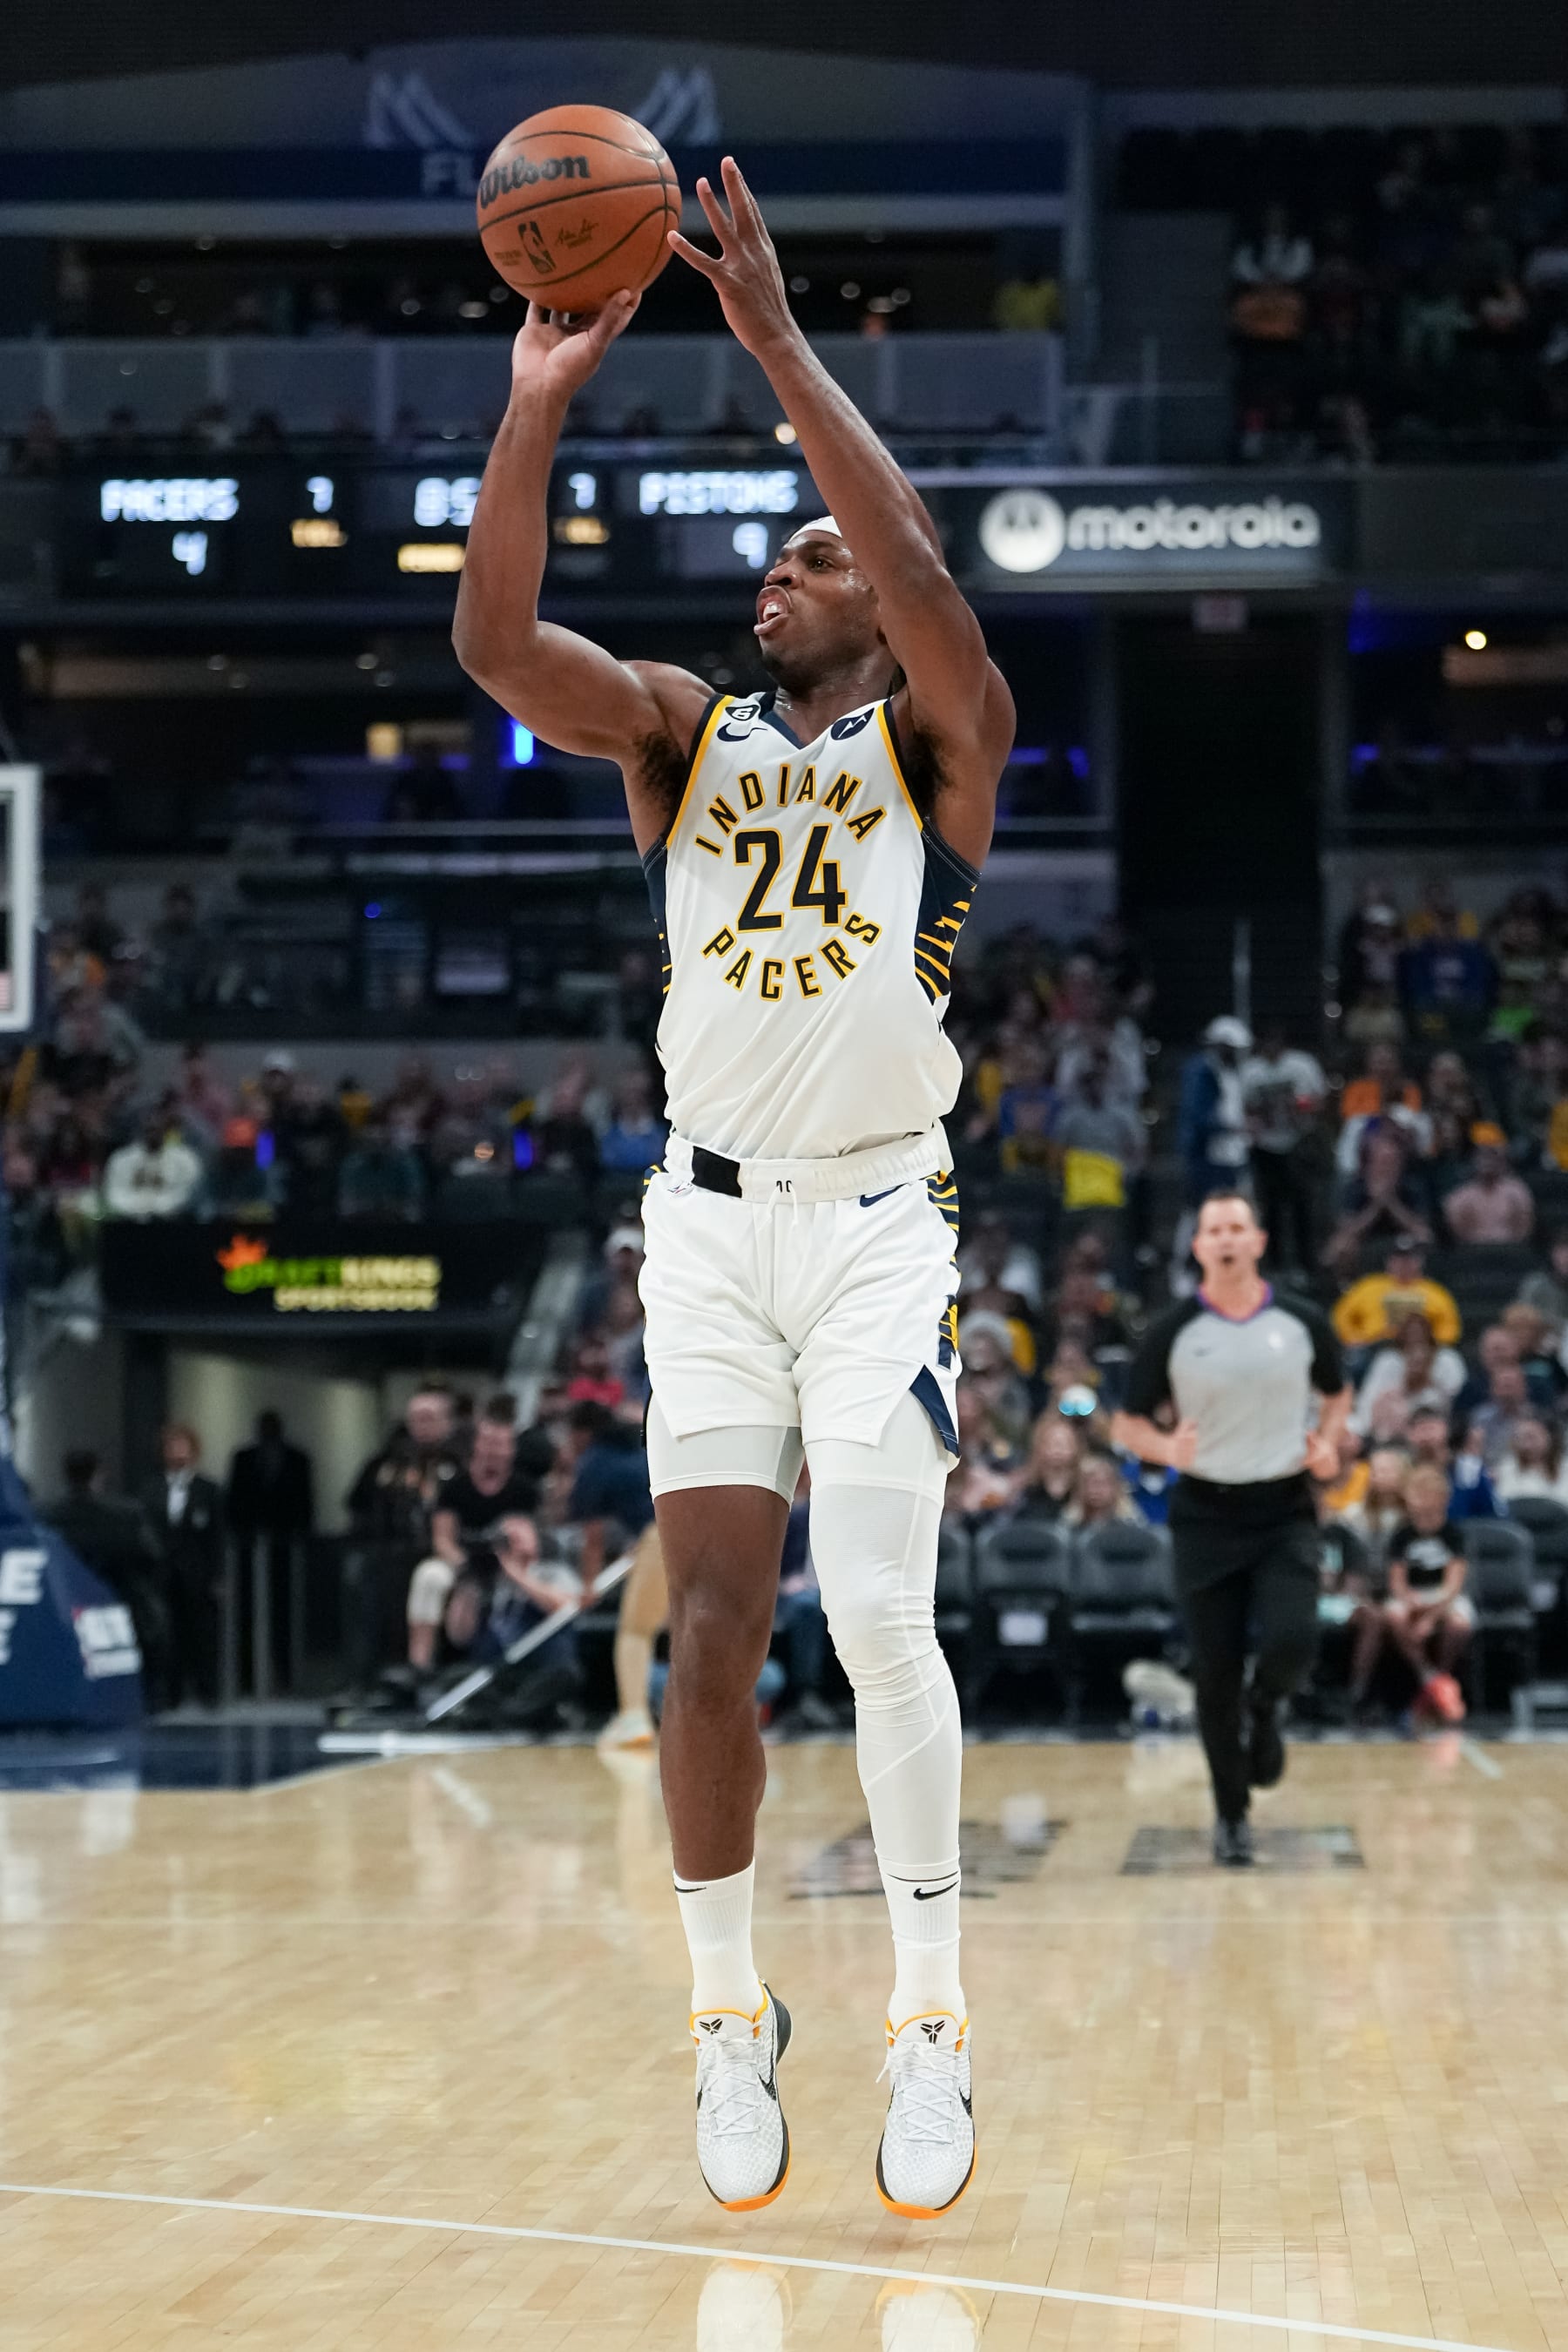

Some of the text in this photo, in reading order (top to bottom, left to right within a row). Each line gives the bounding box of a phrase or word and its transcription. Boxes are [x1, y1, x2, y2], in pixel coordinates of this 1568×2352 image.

[480, 155, 591, 209] Wilson
[1067, 495, 1321, 551] motorola
[695, 763, 887, 858] INDIANA
[733, 822, 848, 935] 24
[701, 912, 882, 1002] PACERS
